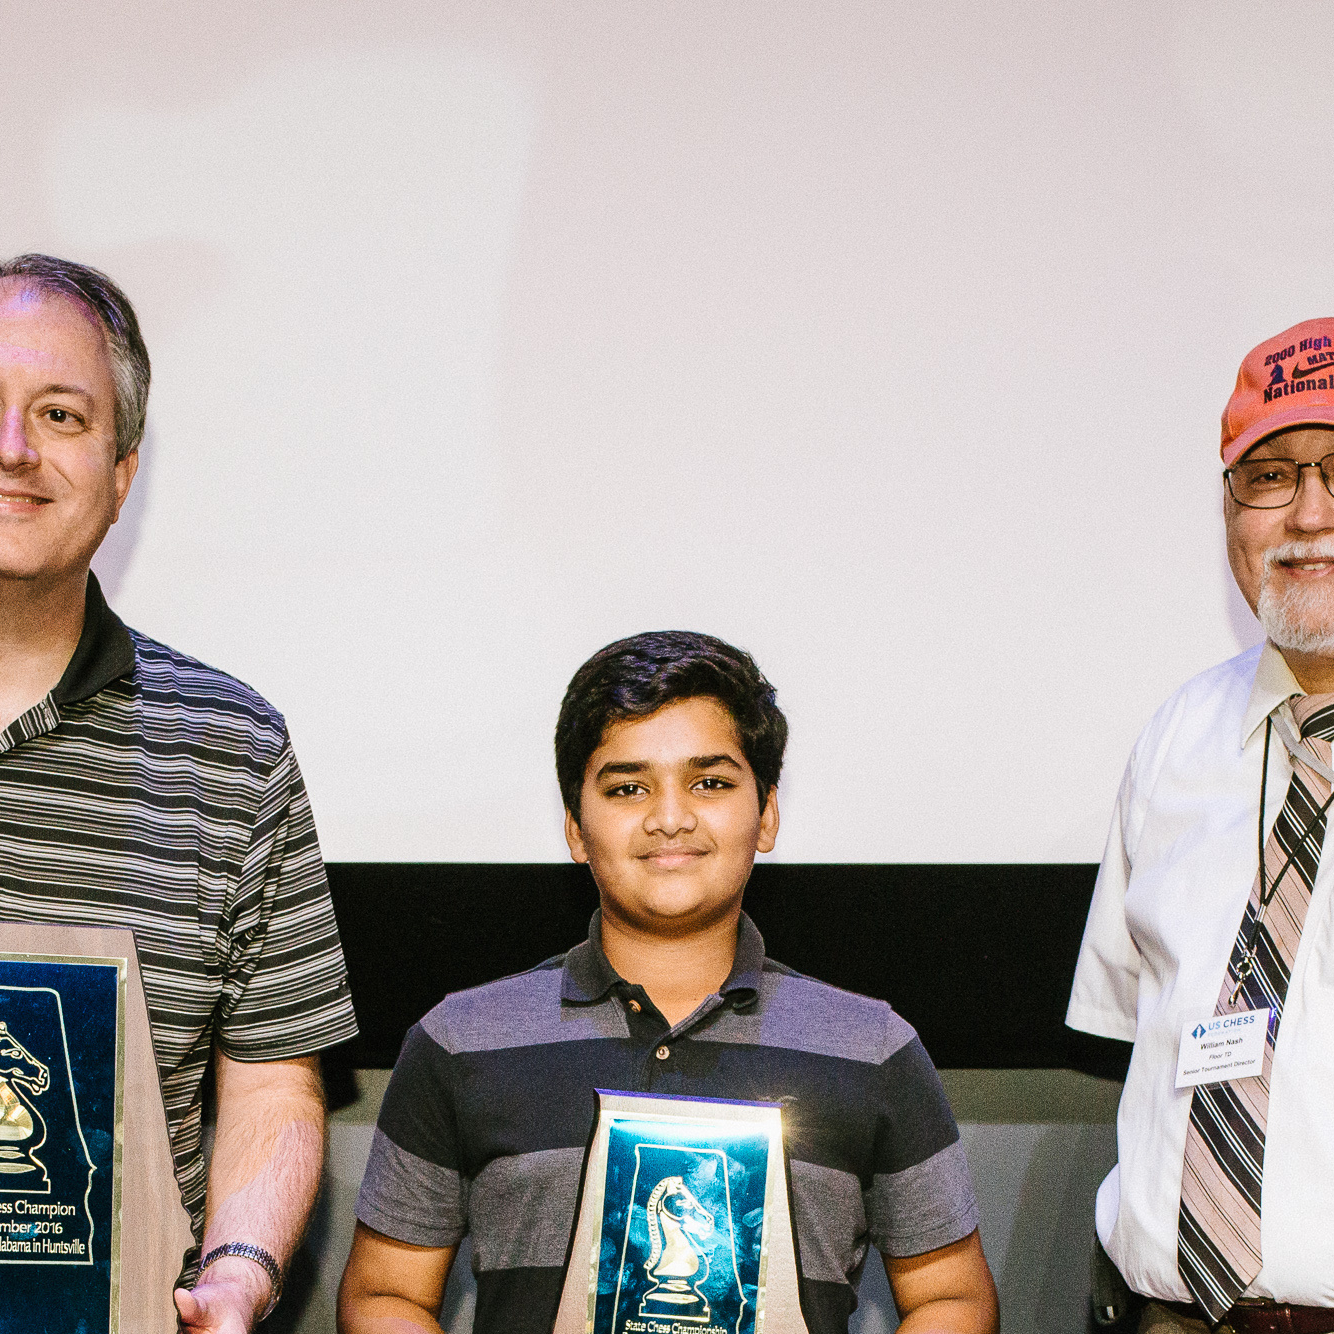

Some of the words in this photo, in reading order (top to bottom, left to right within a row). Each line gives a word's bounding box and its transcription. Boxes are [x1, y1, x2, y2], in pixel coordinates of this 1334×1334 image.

[1264, 345, 1295, 366] 2000
[1299, 336, 1332, 351] High
[1264, 374, 1334, 404] National
[1208, 1020, 1221, 1030] US
[1223, 1015, 1255, 1028] CHESS
[1200, 1041, 1224, 1050] William
[1226, 1037, 1243, 1046] Nash
[1201, 1063, 1233, 1072] Tournament
[1233, 1059, 1256, 1067] Director
[14, 1200, 76, 1219] Champion
[34, 1222, 63, 1234] 2016
[32, 1238, 41, 1253] in
[42, 1238, 85, 1254] Huntsville
[625, 1319, 646, 1332] State
[647, 1320, 671, 1334] Chess
